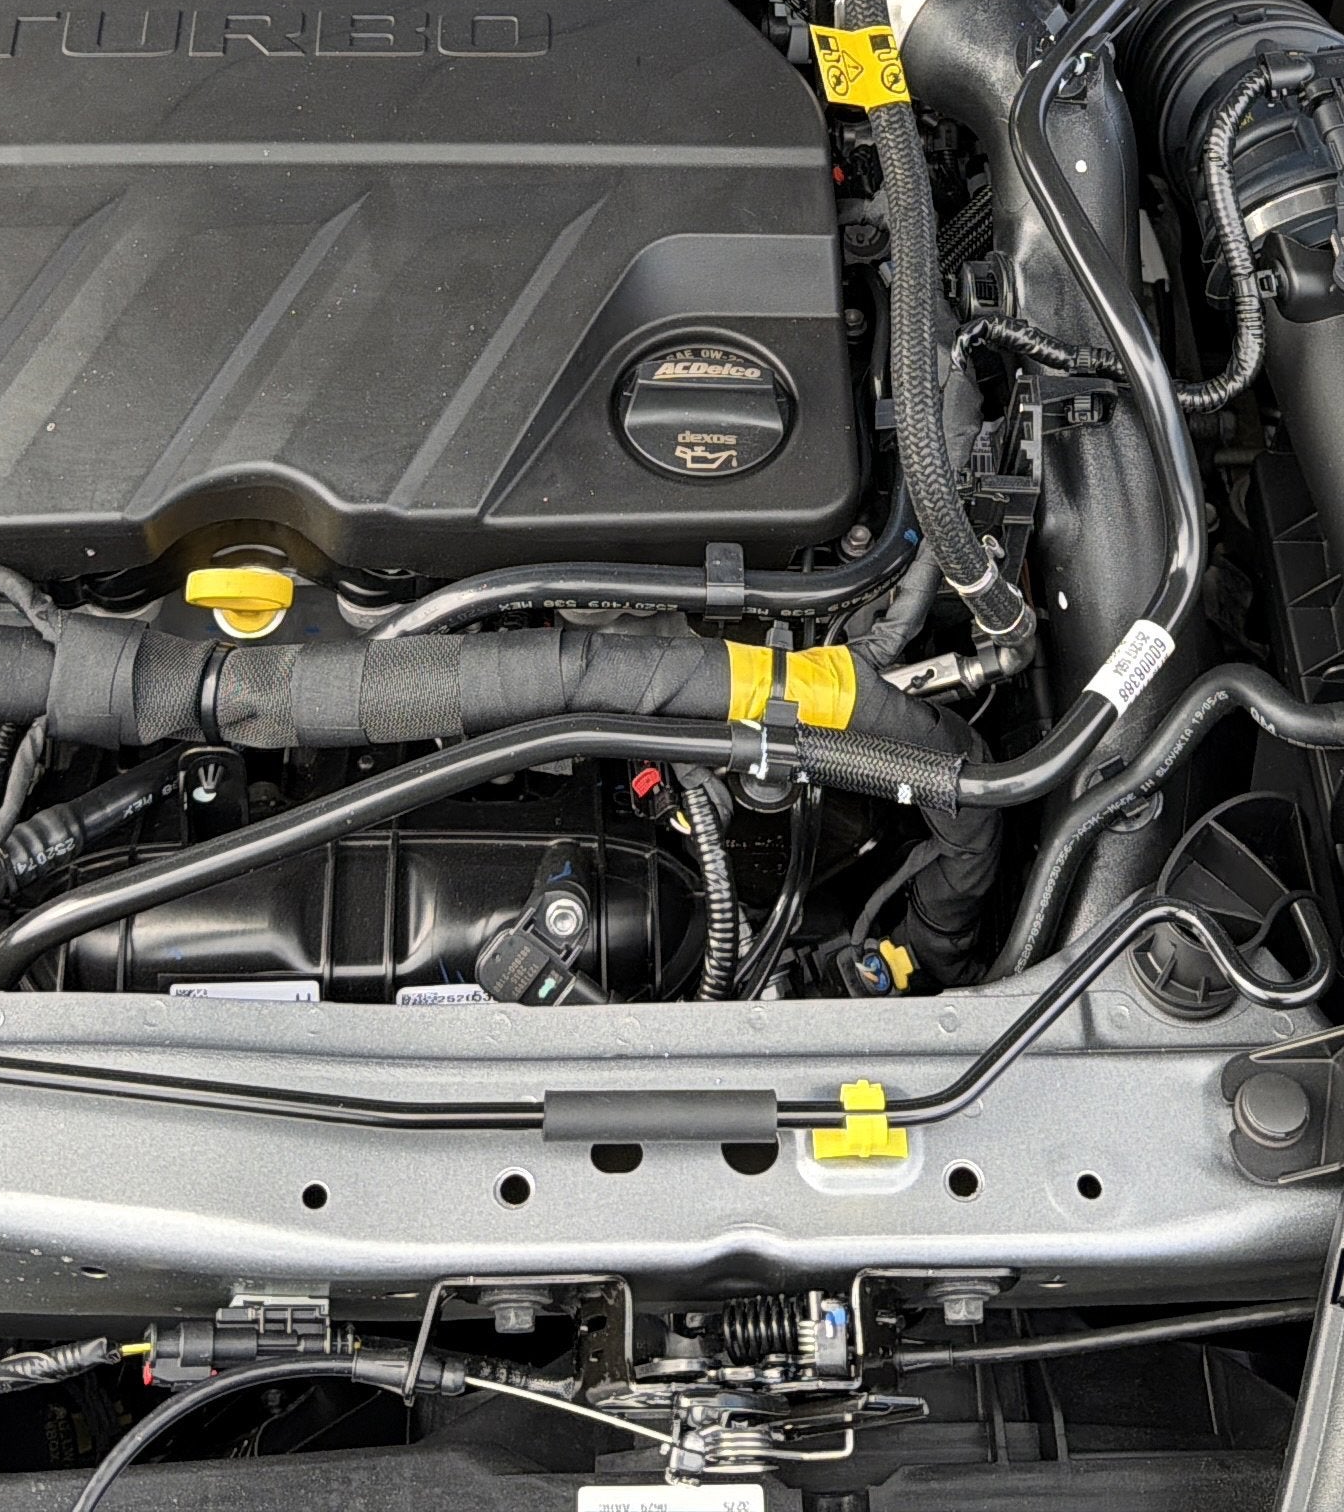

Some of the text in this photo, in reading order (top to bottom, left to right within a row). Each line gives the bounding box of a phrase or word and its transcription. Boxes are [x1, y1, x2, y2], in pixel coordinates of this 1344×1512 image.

[654, 361, 762, 379] ACDelco
[677, 429, 737, 445] dexos
[1155, 728, 1195, 778] SLOVAKIA
[121, 792, 154, 820] MEX
